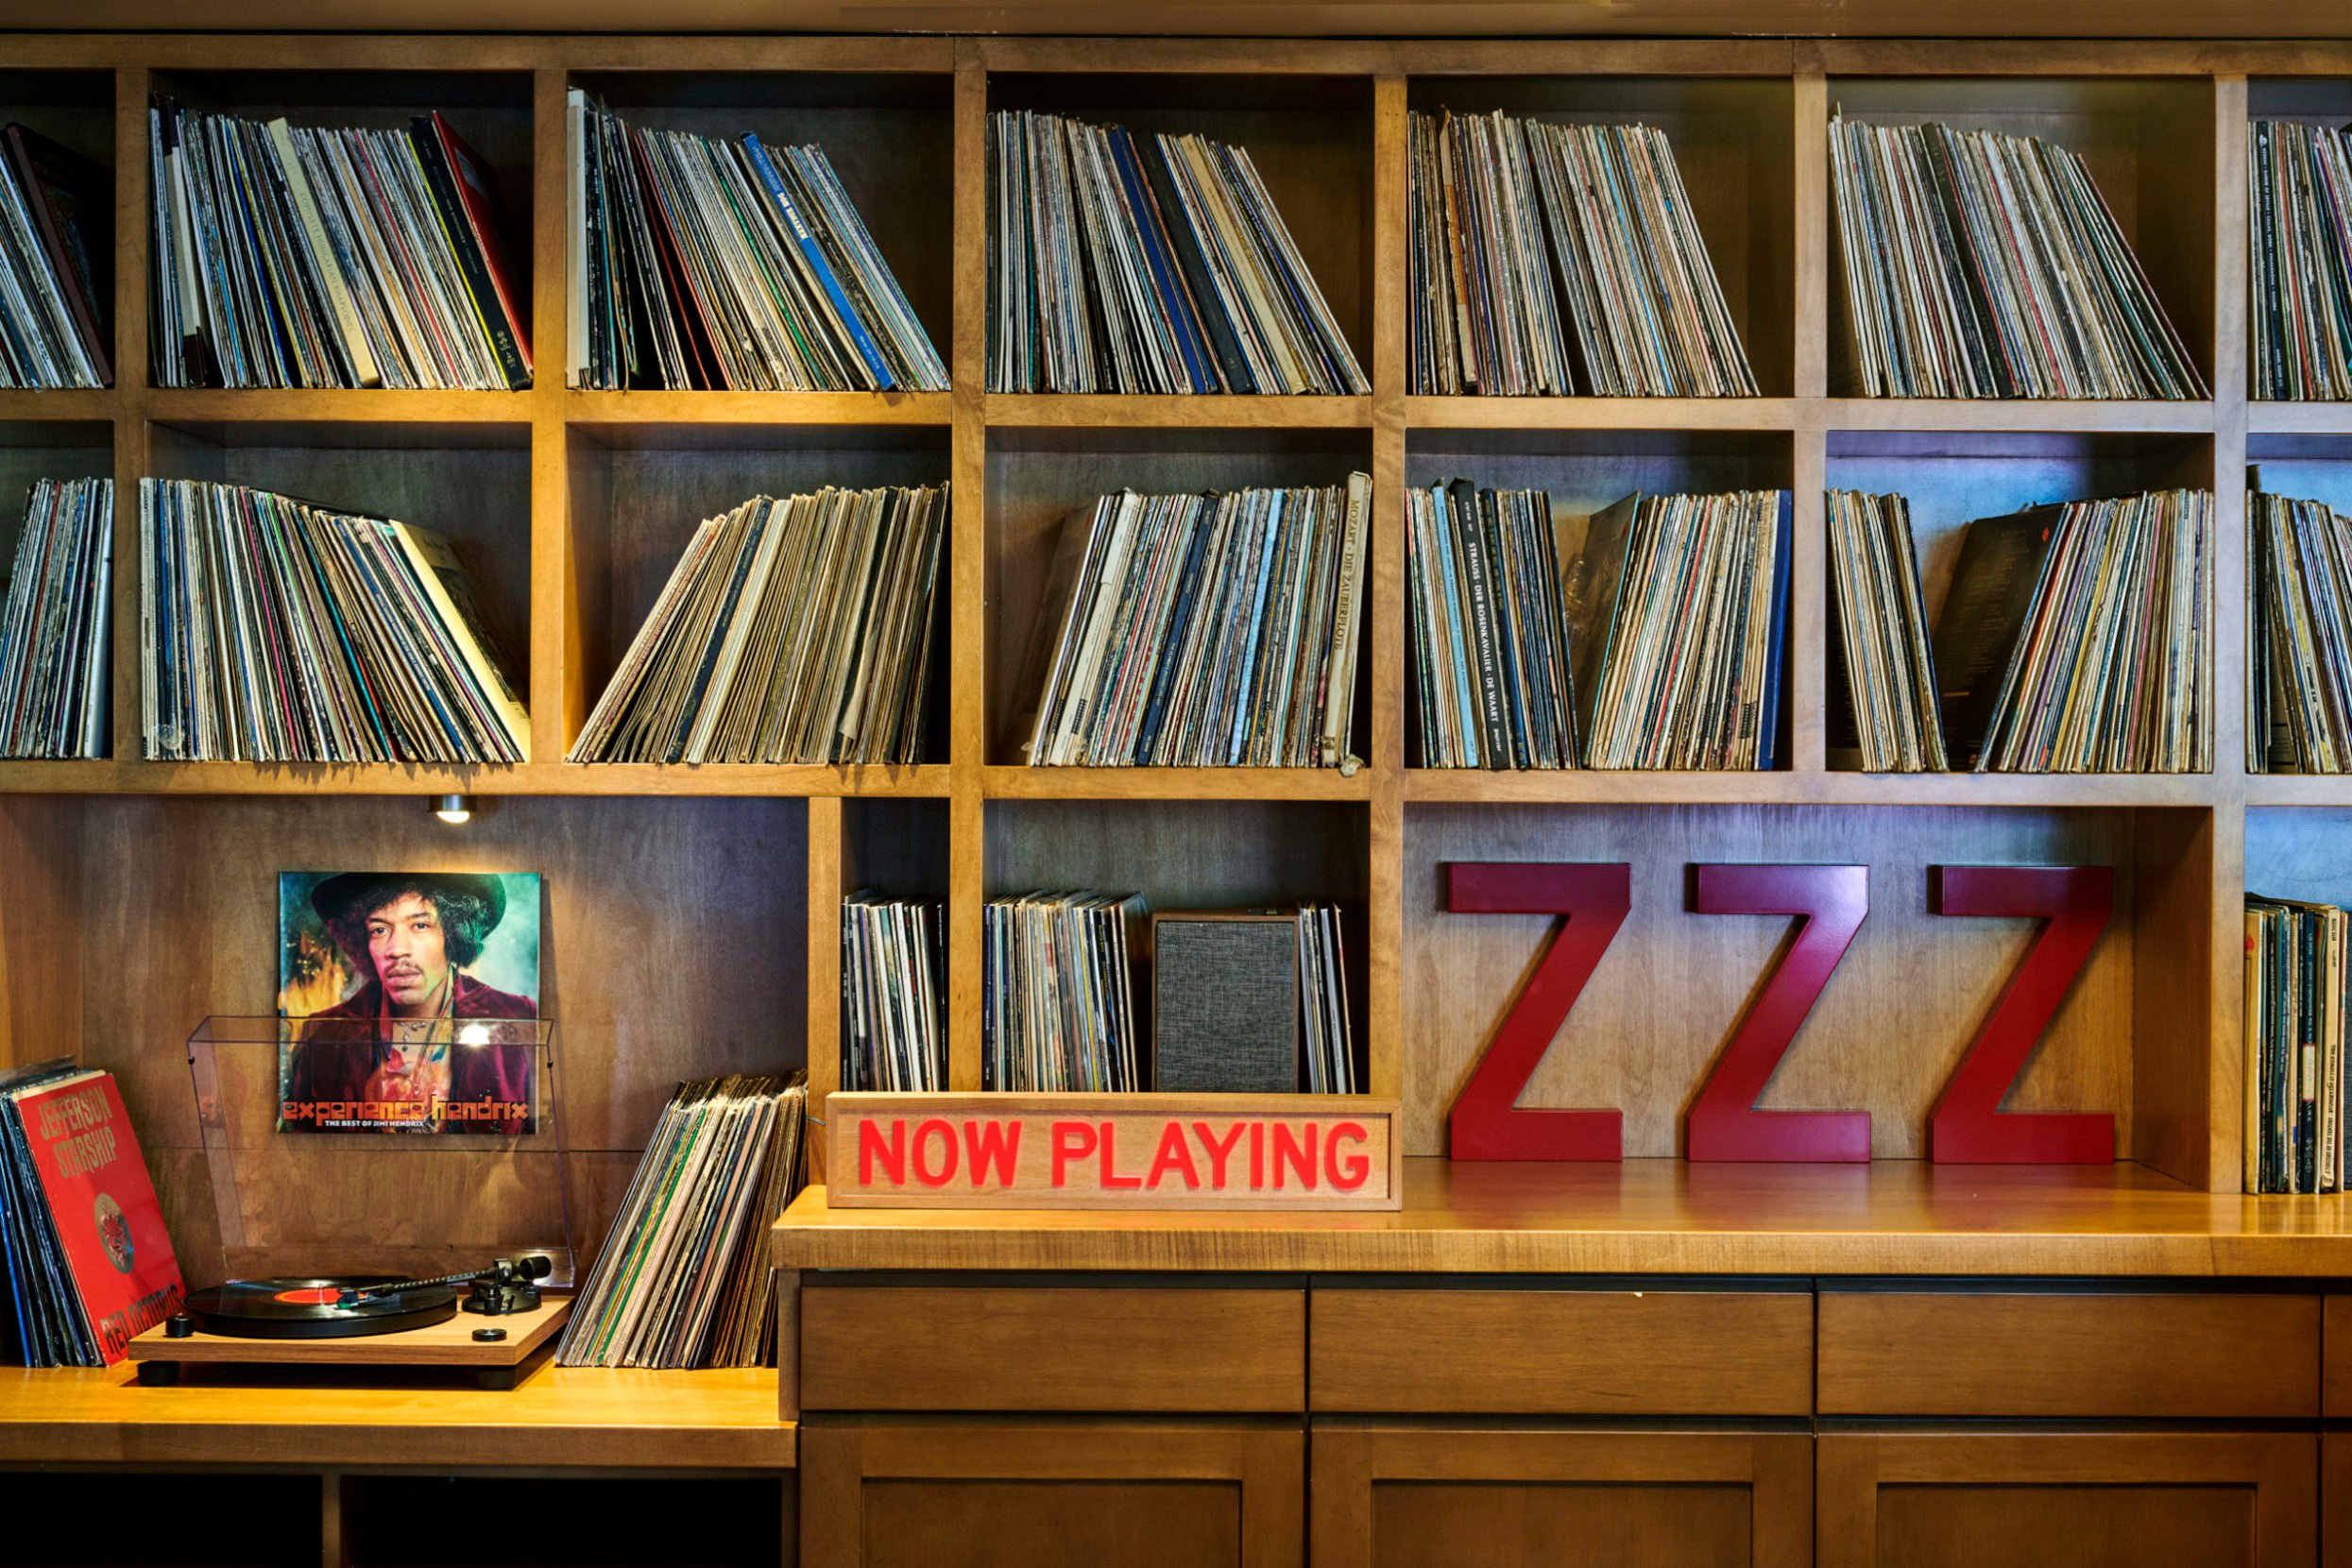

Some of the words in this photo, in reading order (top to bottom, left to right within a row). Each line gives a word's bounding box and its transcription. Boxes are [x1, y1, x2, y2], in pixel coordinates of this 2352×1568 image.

[776, 191, 790, 208] DON
[785, 206, 809, 240] KOSAKEN
[314, 234, 338, 282] HUNGARIAN
[1345, 499, 1359, 544] MOZART
[1342, 552, 1354, 571] DIE
[1468, 541, 1480, 579] STRAUSS
[1474, 584, 1483, 602] DER
[1475, 603, 1492, 672] ROSENKAVALIER
[1485, 676, 1493, 689] DE
[1487, 690, 1498, 722] WAART
[37, 1085, 112, 1141] JEFFERSON
[282, 1100, 425, 1127] experience
[431, 1094, 528, 1120] hendrix
[389, 1119, 424, 1128] HENDRIX
[53, 1126, 117, 1180] STARSHIP
[859, 1118, 1022, 1187] NOW
[1051, 1120, 1371, 1191] PLAYING
[100, 1310, 132, 1355] RED
[128, 1284, 182, 1333] OCTOPUS
